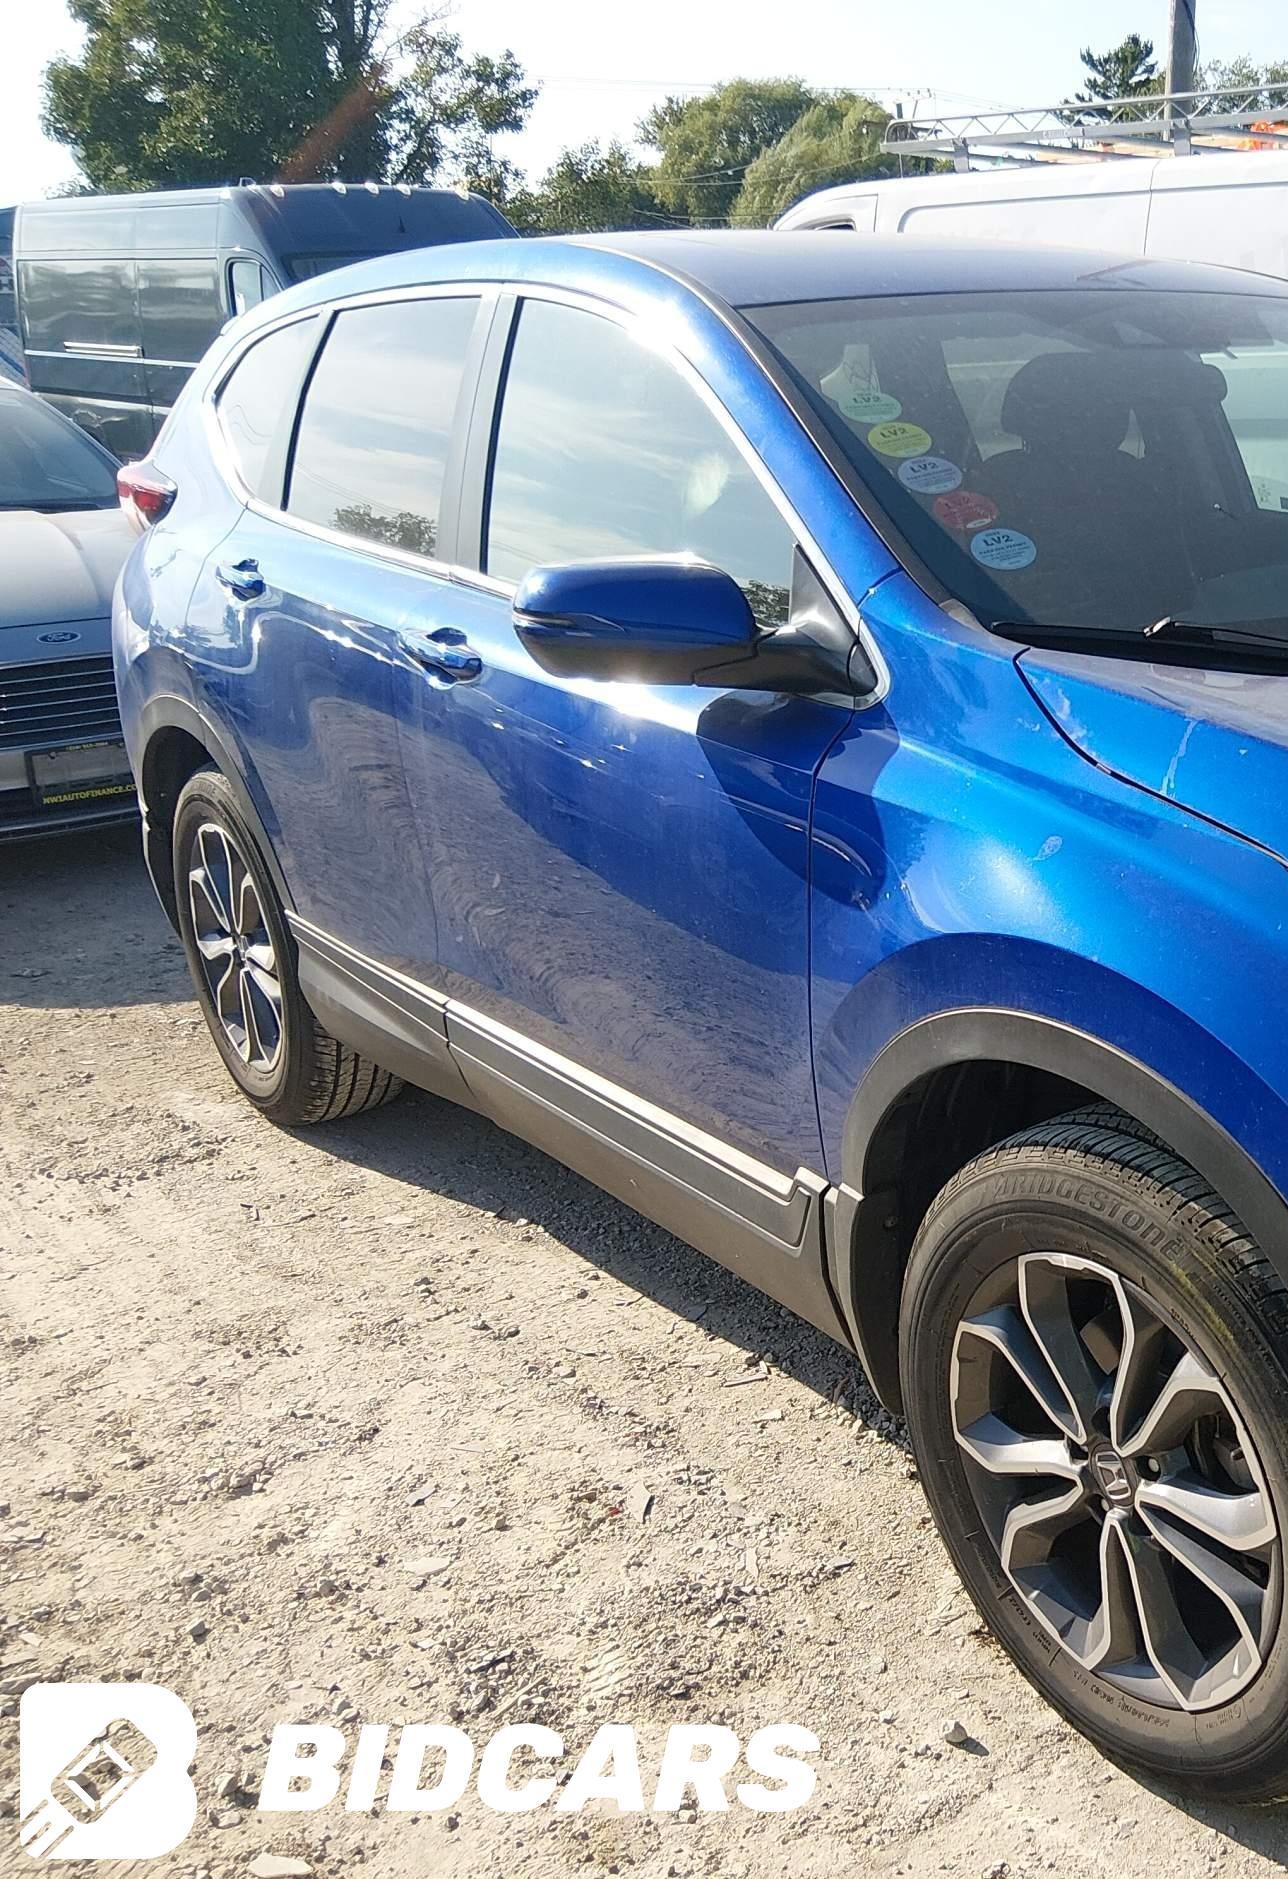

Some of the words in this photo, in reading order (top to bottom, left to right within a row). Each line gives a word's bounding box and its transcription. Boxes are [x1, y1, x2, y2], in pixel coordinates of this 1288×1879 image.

[910, 462, 938, 473] LV2
[983, 535, 1014, 546] LV2
[43, 783, 138, 805] NWIAUTOFINANCE.CO
[993, 1173, 1187, 1263] BRIDGESTONE
